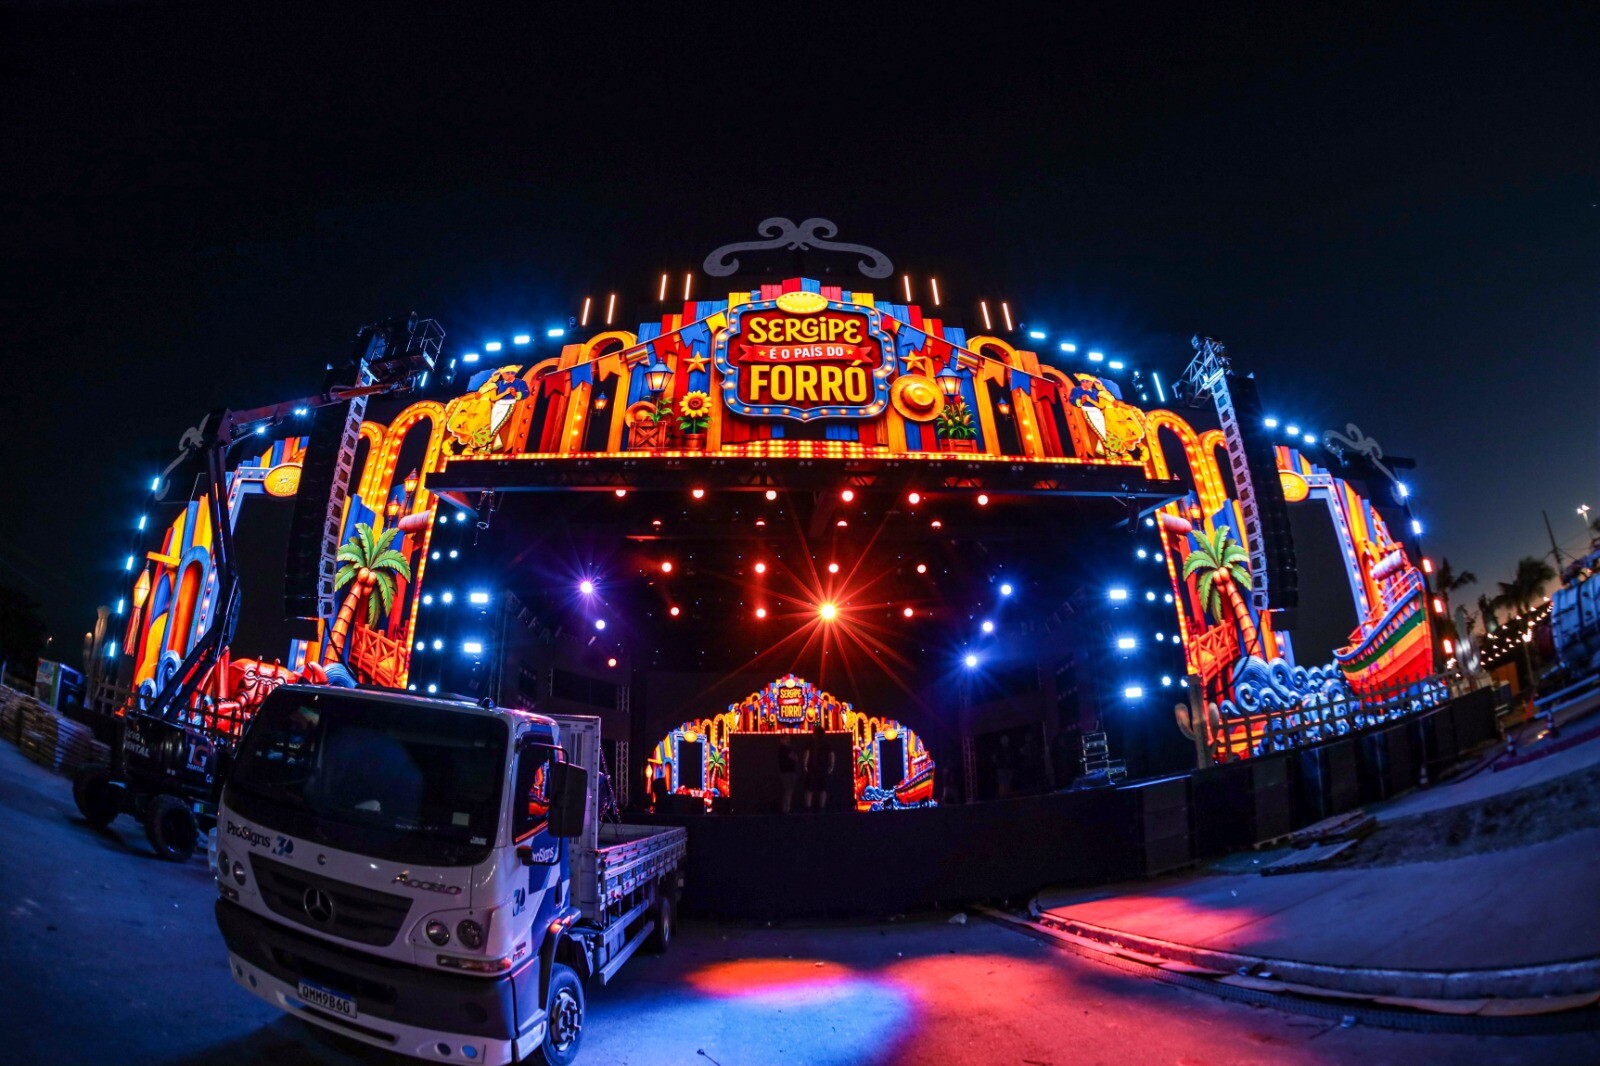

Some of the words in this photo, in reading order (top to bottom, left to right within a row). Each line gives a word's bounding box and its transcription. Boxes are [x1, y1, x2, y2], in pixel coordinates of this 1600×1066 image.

[769, 346, 777, 359] É
[781, 348, 790, 359] O
[794, 346, 823, 359] PAÍS
[826, 346, 844, 357] DO
[750, 359, 867, 403] FORRÓ
[227, 821, 271, 847] ProSigns
